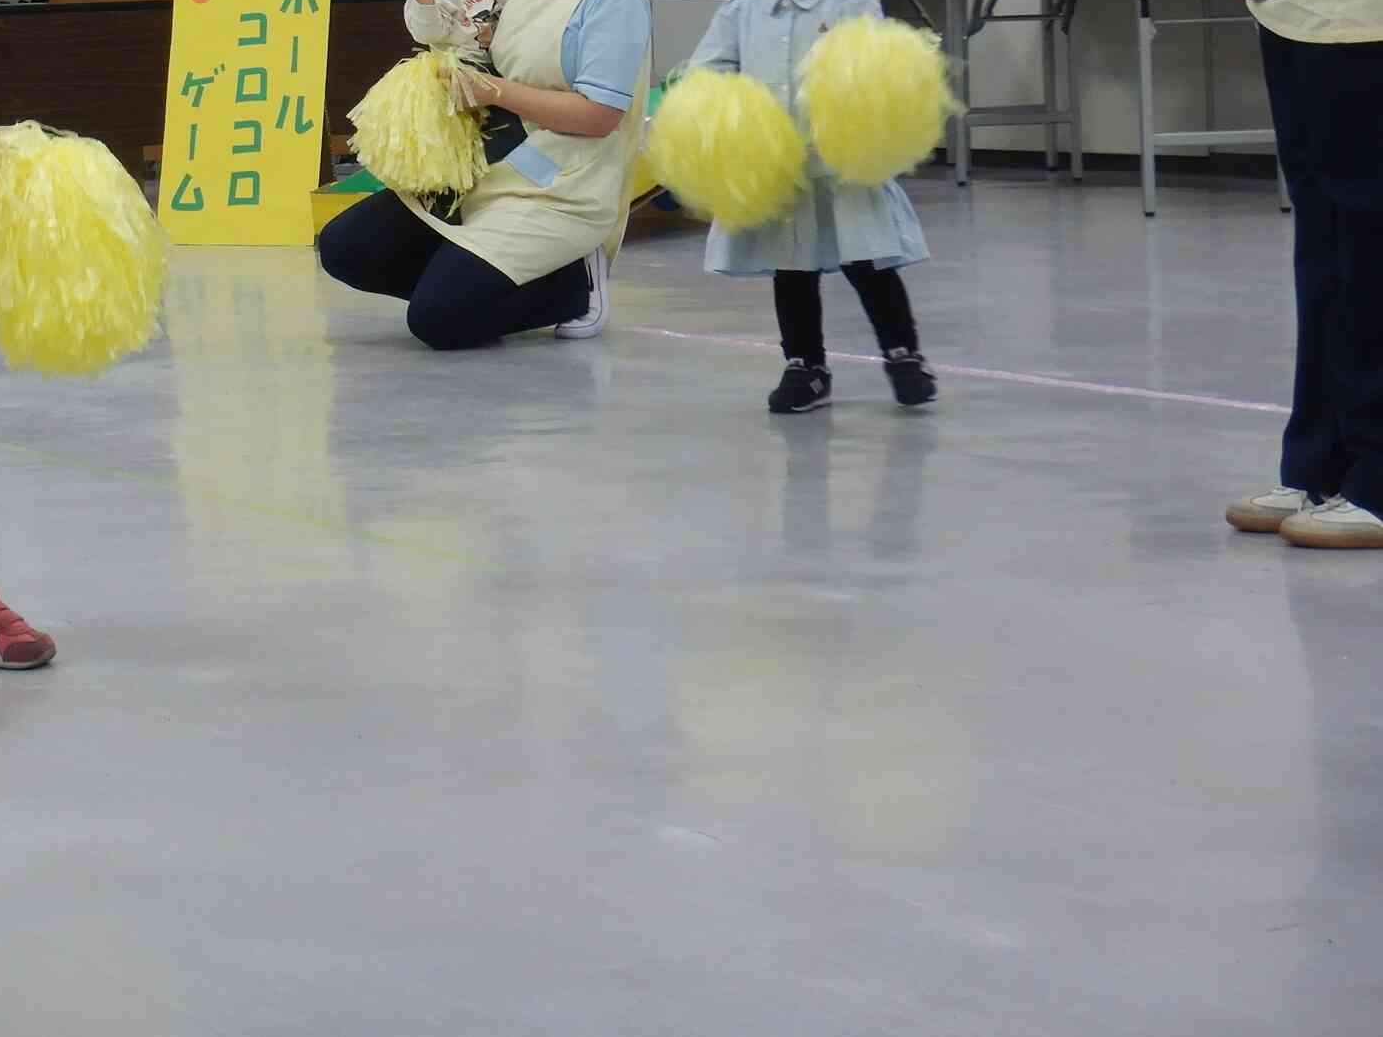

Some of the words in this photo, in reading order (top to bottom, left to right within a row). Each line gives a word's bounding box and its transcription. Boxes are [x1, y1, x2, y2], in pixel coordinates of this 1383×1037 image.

[170, 63, 226, 212] ゲーム
[227, 12, 268, 207] コロコロ
